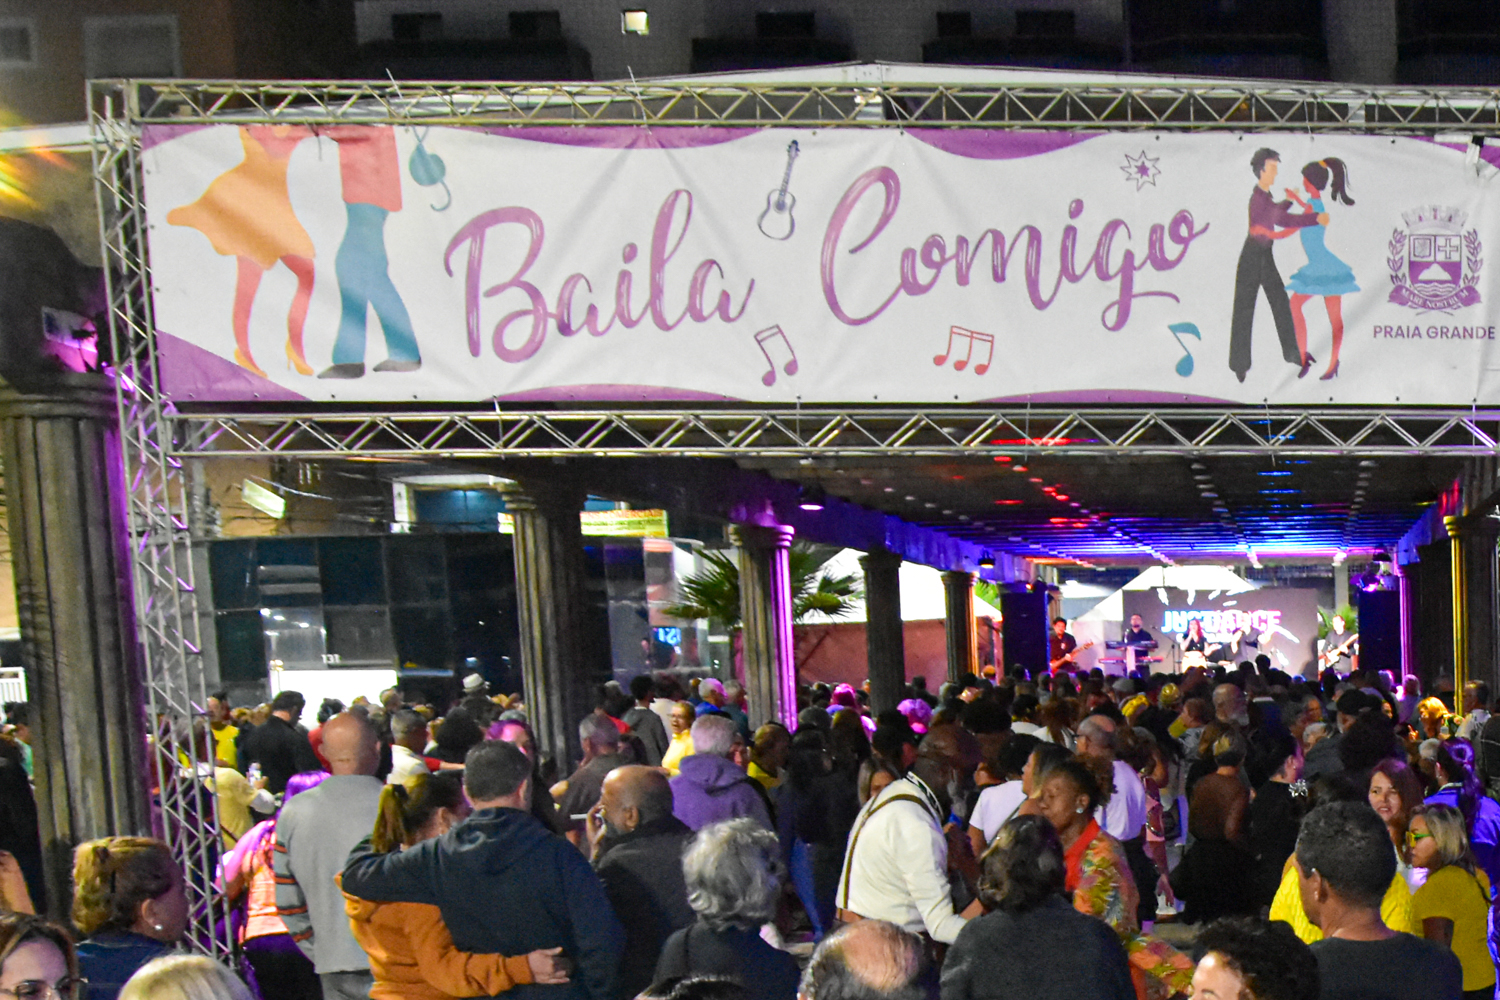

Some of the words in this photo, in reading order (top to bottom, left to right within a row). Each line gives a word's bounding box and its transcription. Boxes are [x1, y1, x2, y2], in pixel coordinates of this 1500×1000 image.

[443, 188, 756, 364] Baila
[820, 165, 1211, 332] Comigo
[1372, 325, 1422, 339] PRAIA
[1426, 325, 1496, 340] GRANDE
[321, 653, 341, 664] 131
